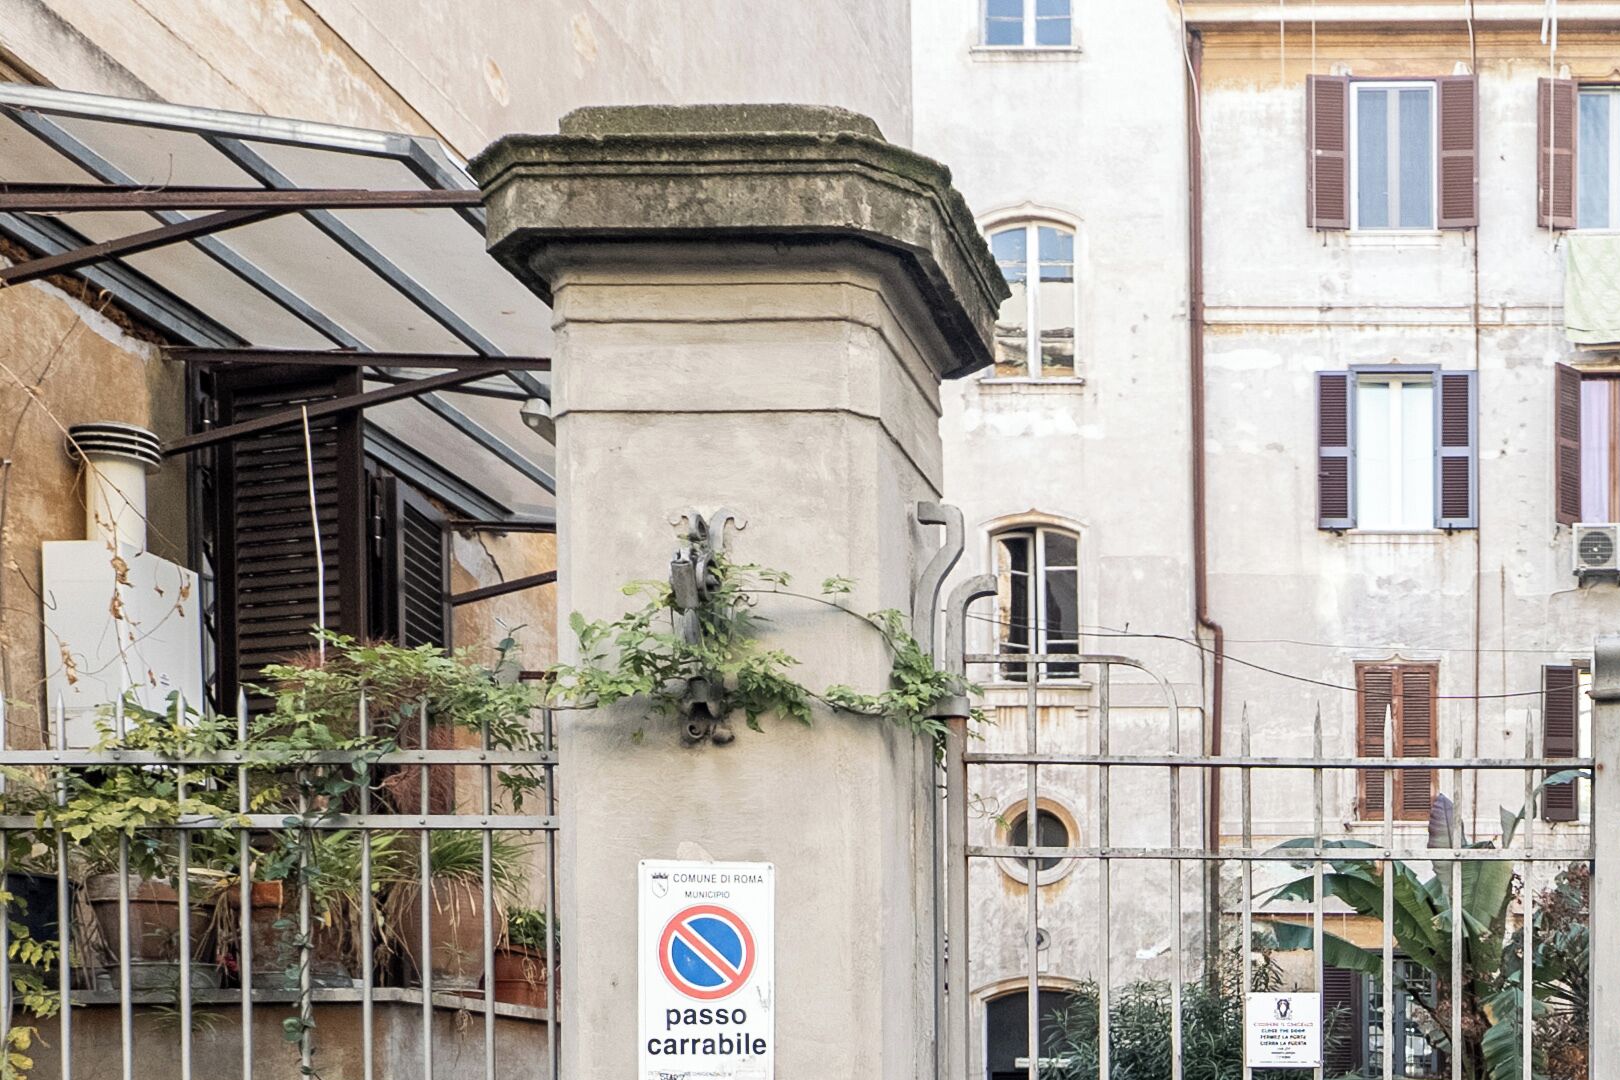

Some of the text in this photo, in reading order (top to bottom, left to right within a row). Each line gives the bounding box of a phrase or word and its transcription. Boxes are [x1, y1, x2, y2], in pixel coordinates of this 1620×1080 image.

[673, 874, 764, 884] COMUNE DI ROMA
[685, 890, 731, 899] MUNICIPIO
[666, 1008, 747, 1030] passo
[647, 1033, 767, 1056] carrabile
